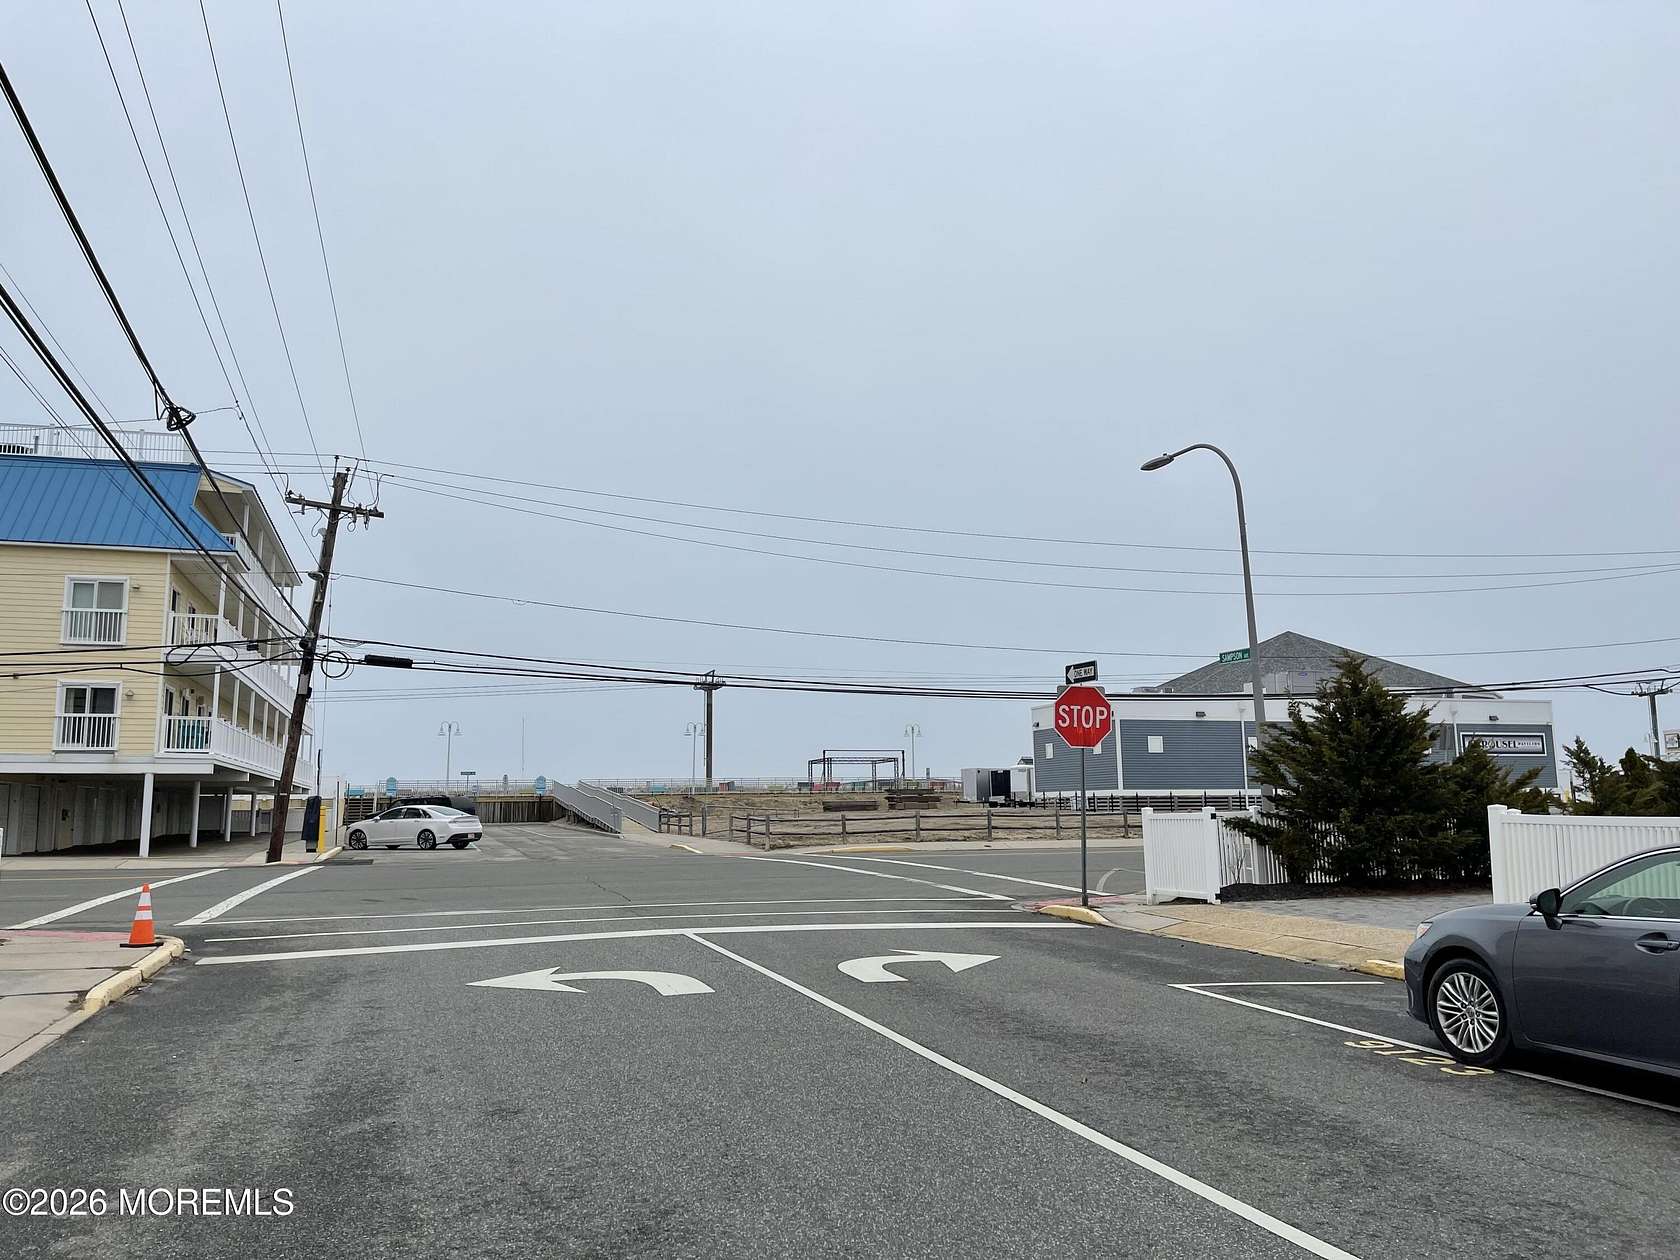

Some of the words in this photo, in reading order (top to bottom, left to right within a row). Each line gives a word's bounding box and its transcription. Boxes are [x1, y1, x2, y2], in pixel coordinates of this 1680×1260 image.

[1221, 651, 1243, 662] SAMPSON
[1073, 669, 1083, 678] ONE
[1084, 666, 1093, 676] WAY
[1058, 704, 1108, 729] STOP
[1344, 1040, 1495, 1076] 9123
